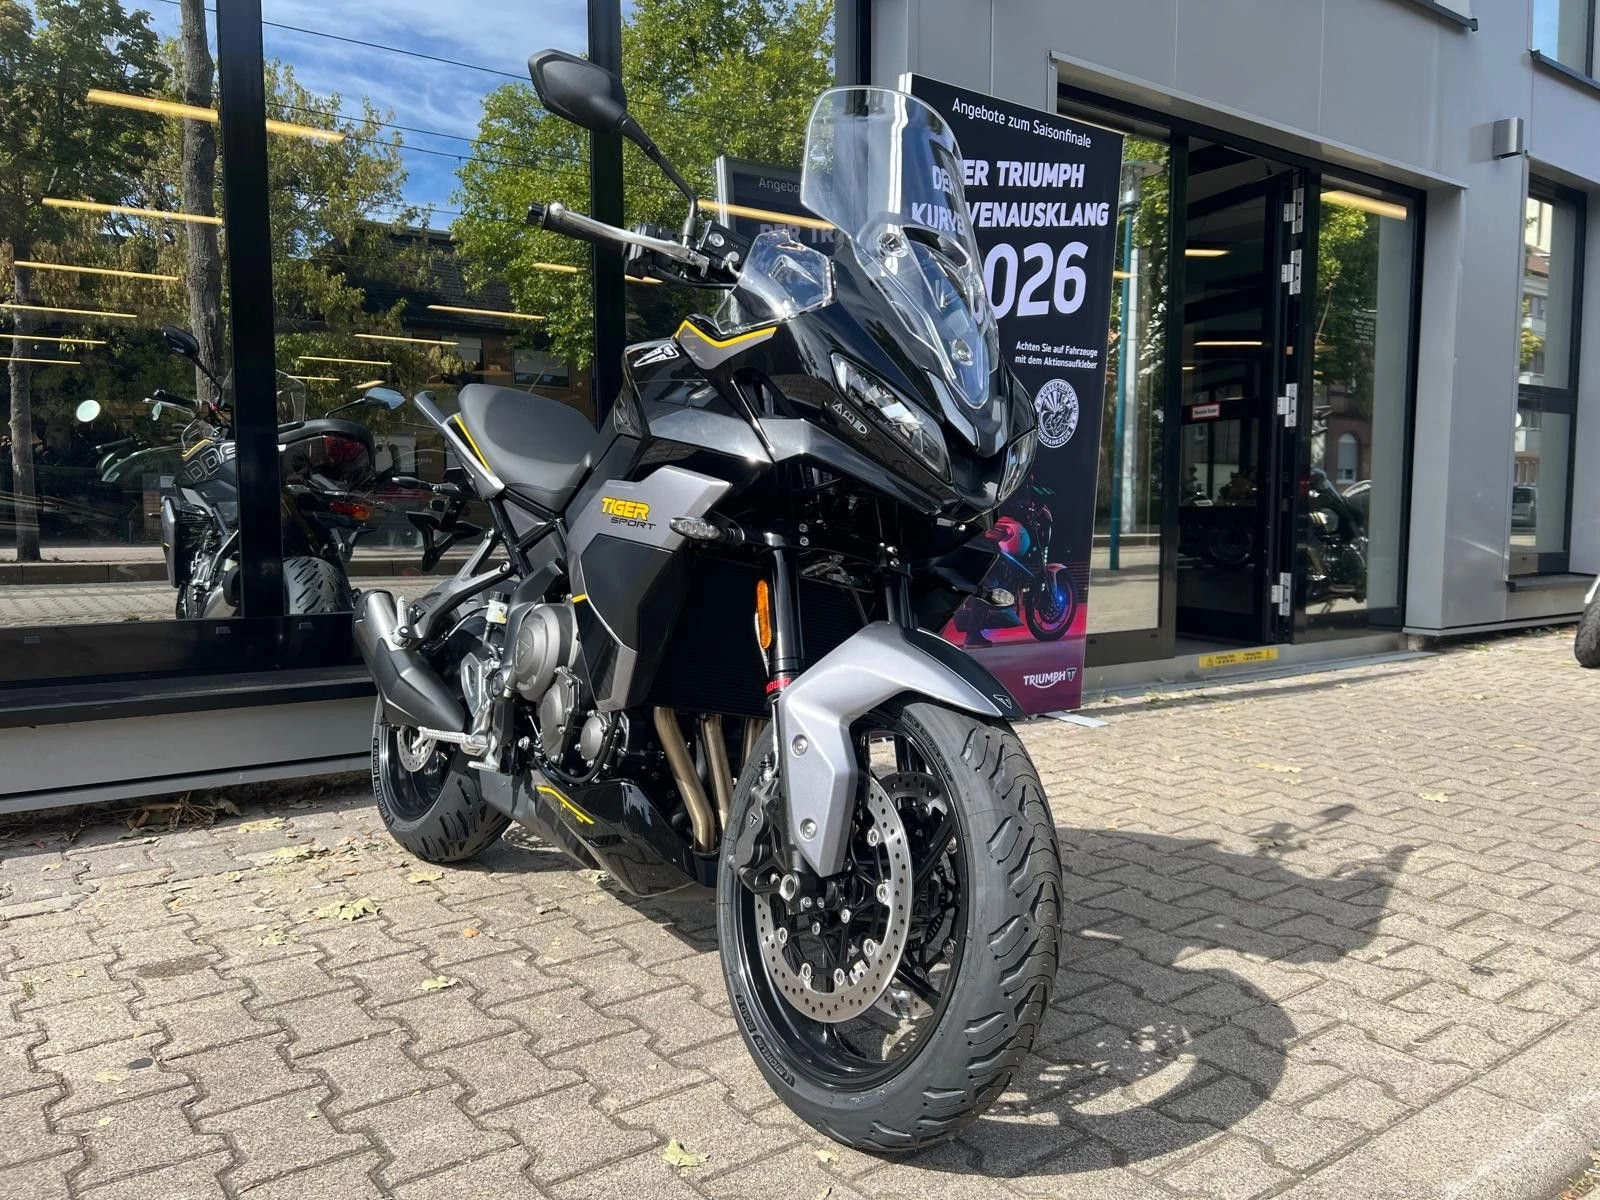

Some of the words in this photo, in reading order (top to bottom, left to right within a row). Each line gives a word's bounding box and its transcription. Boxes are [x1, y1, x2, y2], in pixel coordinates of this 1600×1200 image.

[952, 98, 1005, 125] Angebote
[1008, 115, 1031, 132] zum
[1033, 119, 1092, 148] Saisonfinale
[996, 160, 1085, 188] TRIUMPH
[758, 177, 800, 194] Angebo
[982, 241, 1089, 320] 026
[1015, 340, 1040, 352] Achten
[1041, 343, 1052, 353] Sie
[1053, 345, 1065, 354] auf
[1065, 345, 1098, 358] Fahrzeuge
[1014, 354, 1027, 364] mit
[1027, 356, 1043, 365] dem
[1043, 357, 1098, 369] Aktionsaufkleber
[601, 496, 651, 522] TIGER
[610, 516, 657, 531] SPORT
[1023, 670, 1067, 689] TRIUMPH
